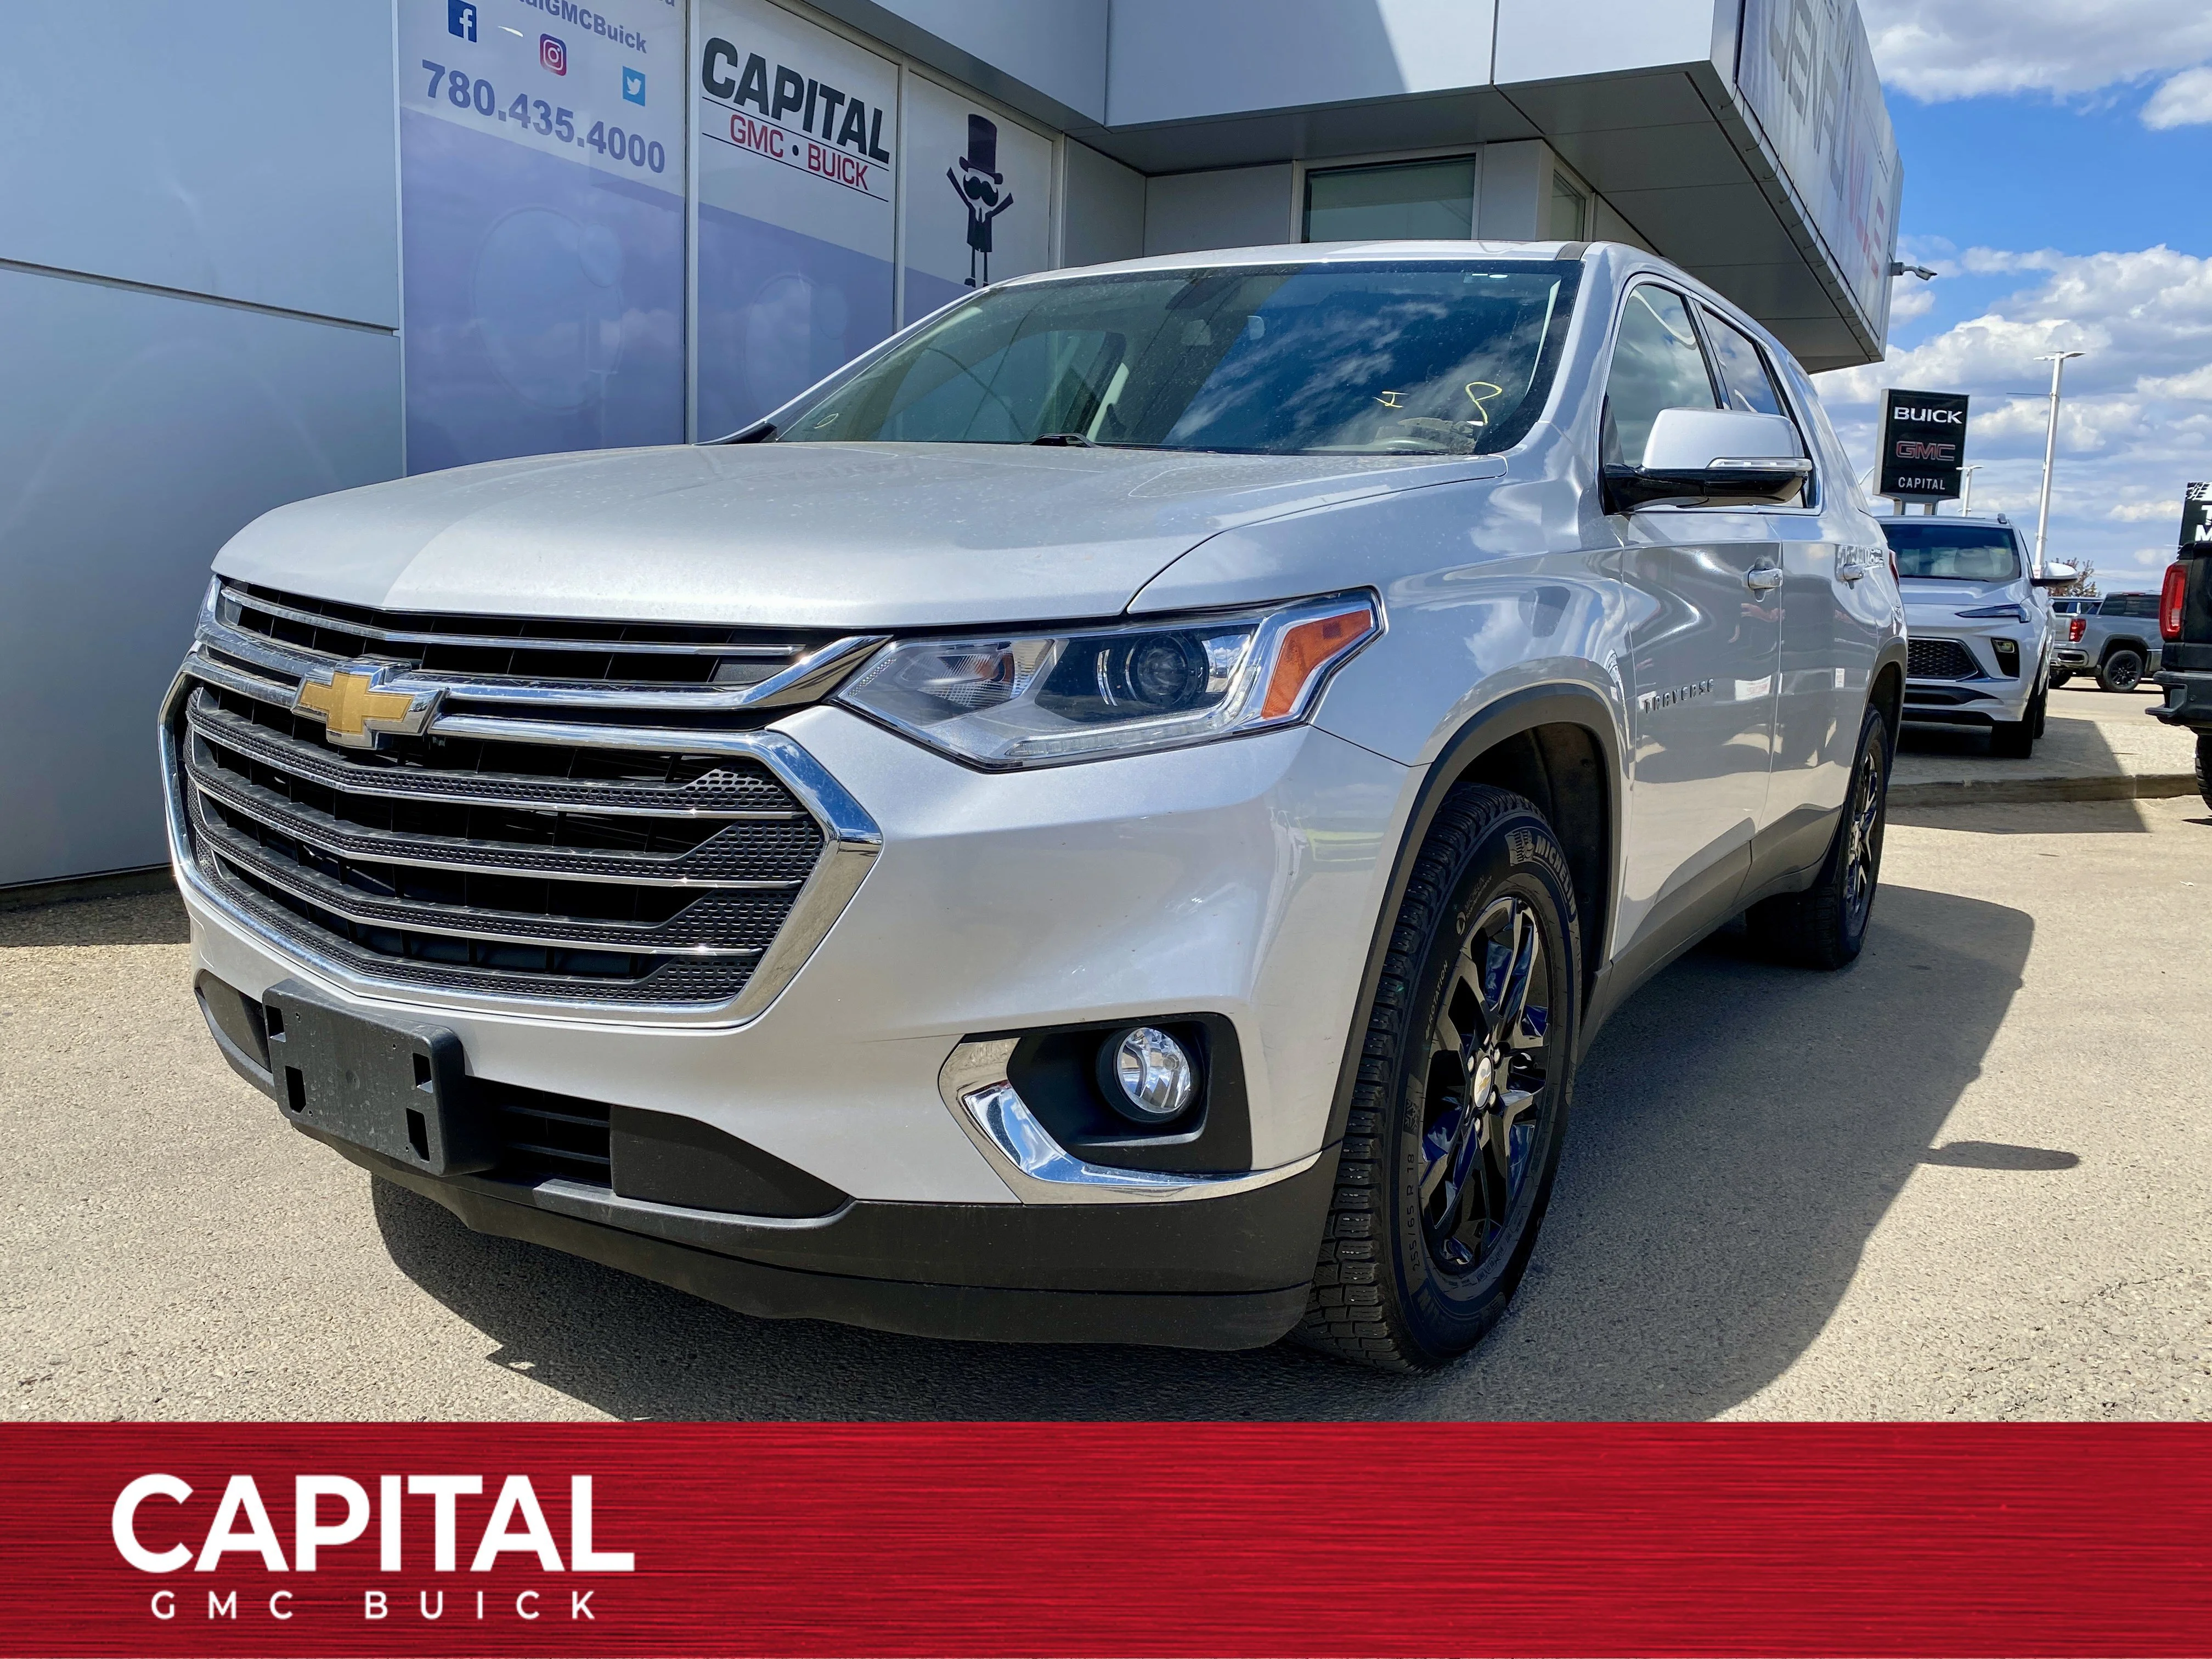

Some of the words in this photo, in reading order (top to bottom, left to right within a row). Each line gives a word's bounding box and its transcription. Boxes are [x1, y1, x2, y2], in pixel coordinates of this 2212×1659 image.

[422, 59, 665, 174] 780.435.4000
[702, 37, 890, 165] CAPITAL
[730, 114, 784, 159] GMC
[808, 142, 868, 191] BUICK
[1894, 406, 1963, 424] BUICK
[1895, 440, 1956, 461] GMC
[1898, 476, 1945, 490] CAPITAL
[1643, 678, 1714, 714] TRAVERSE
[1534, 834, 1577, 916] MICHELIN
[1427, 959, 1448, 1025] ROTATION
[1406, 1153, 1415, 1173] 18
[1406, 1205, 1421, 1272] 255/65
